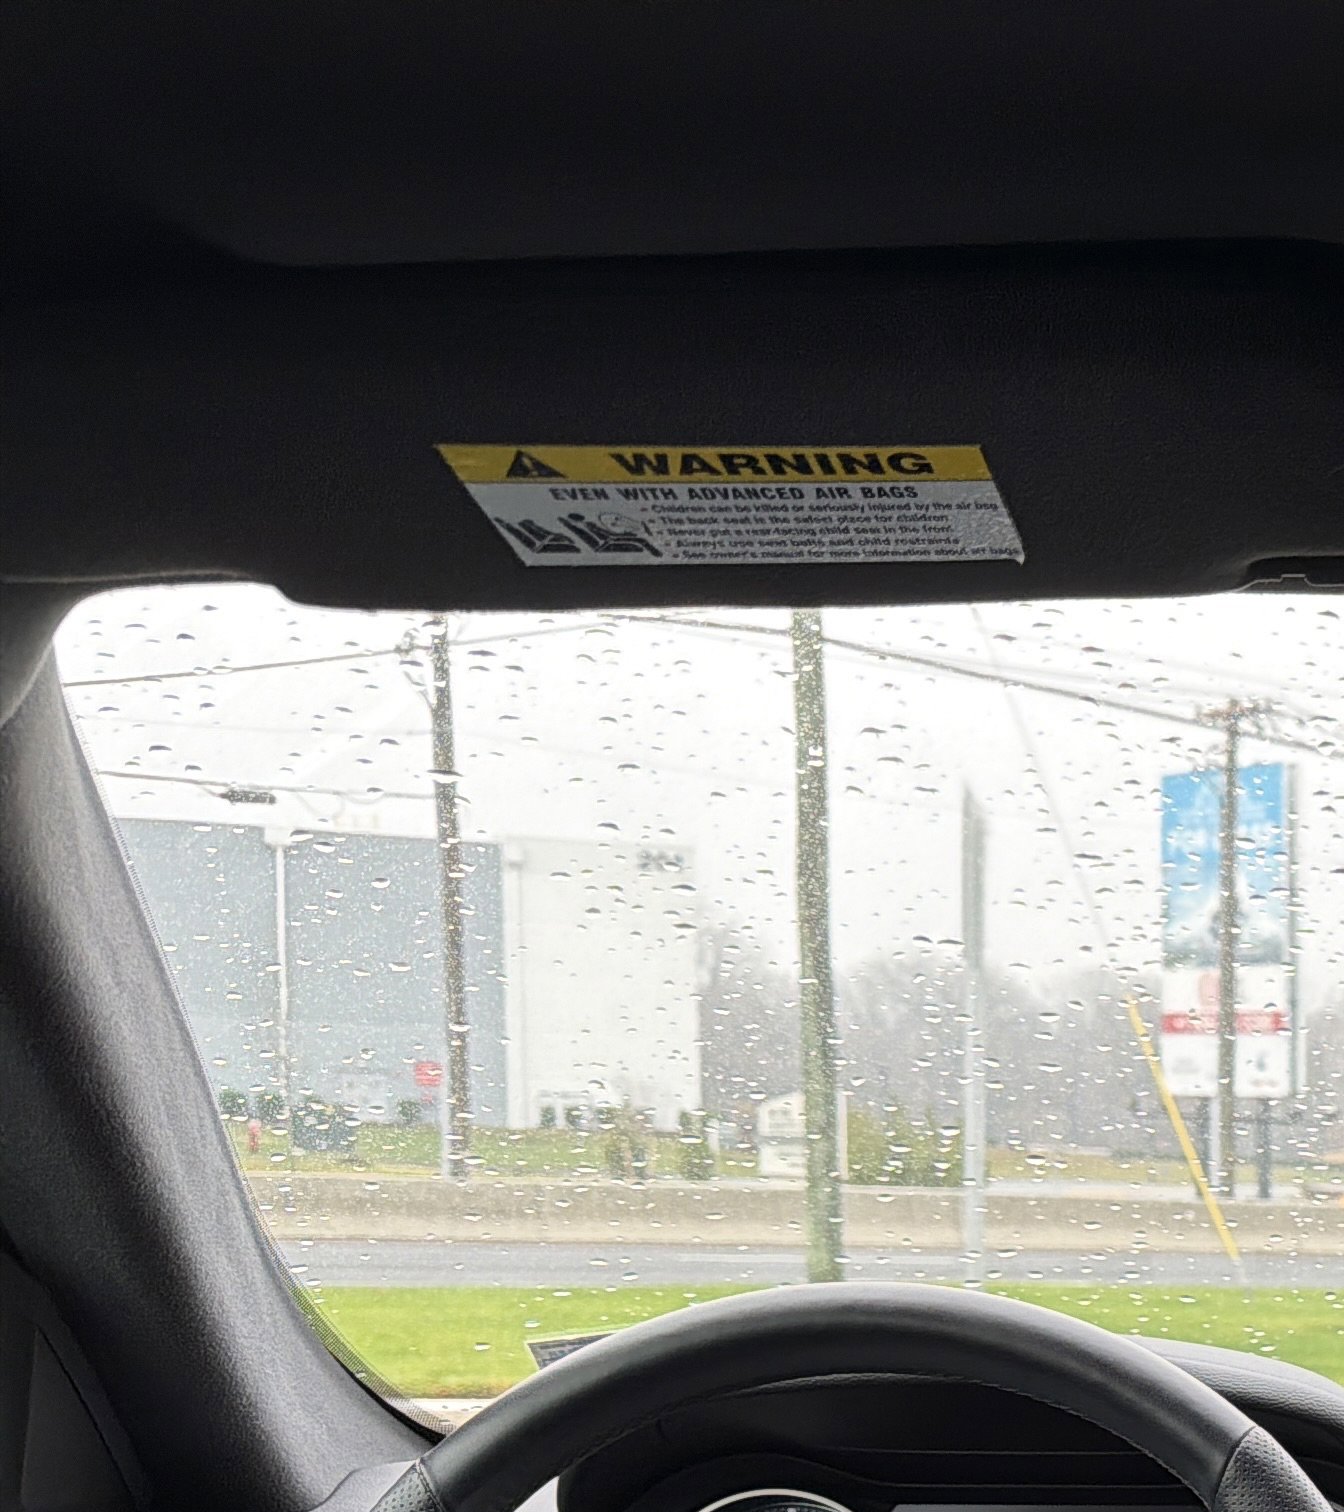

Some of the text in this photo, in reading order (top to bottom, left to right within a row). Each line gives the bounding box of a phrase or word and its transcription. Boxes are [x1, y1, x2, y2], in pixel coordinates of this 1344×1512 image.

[608, 452, 935, 476] WARNING
[549, 485, 919, 501] EVEN WITH ADVANCED AIR BAGS
